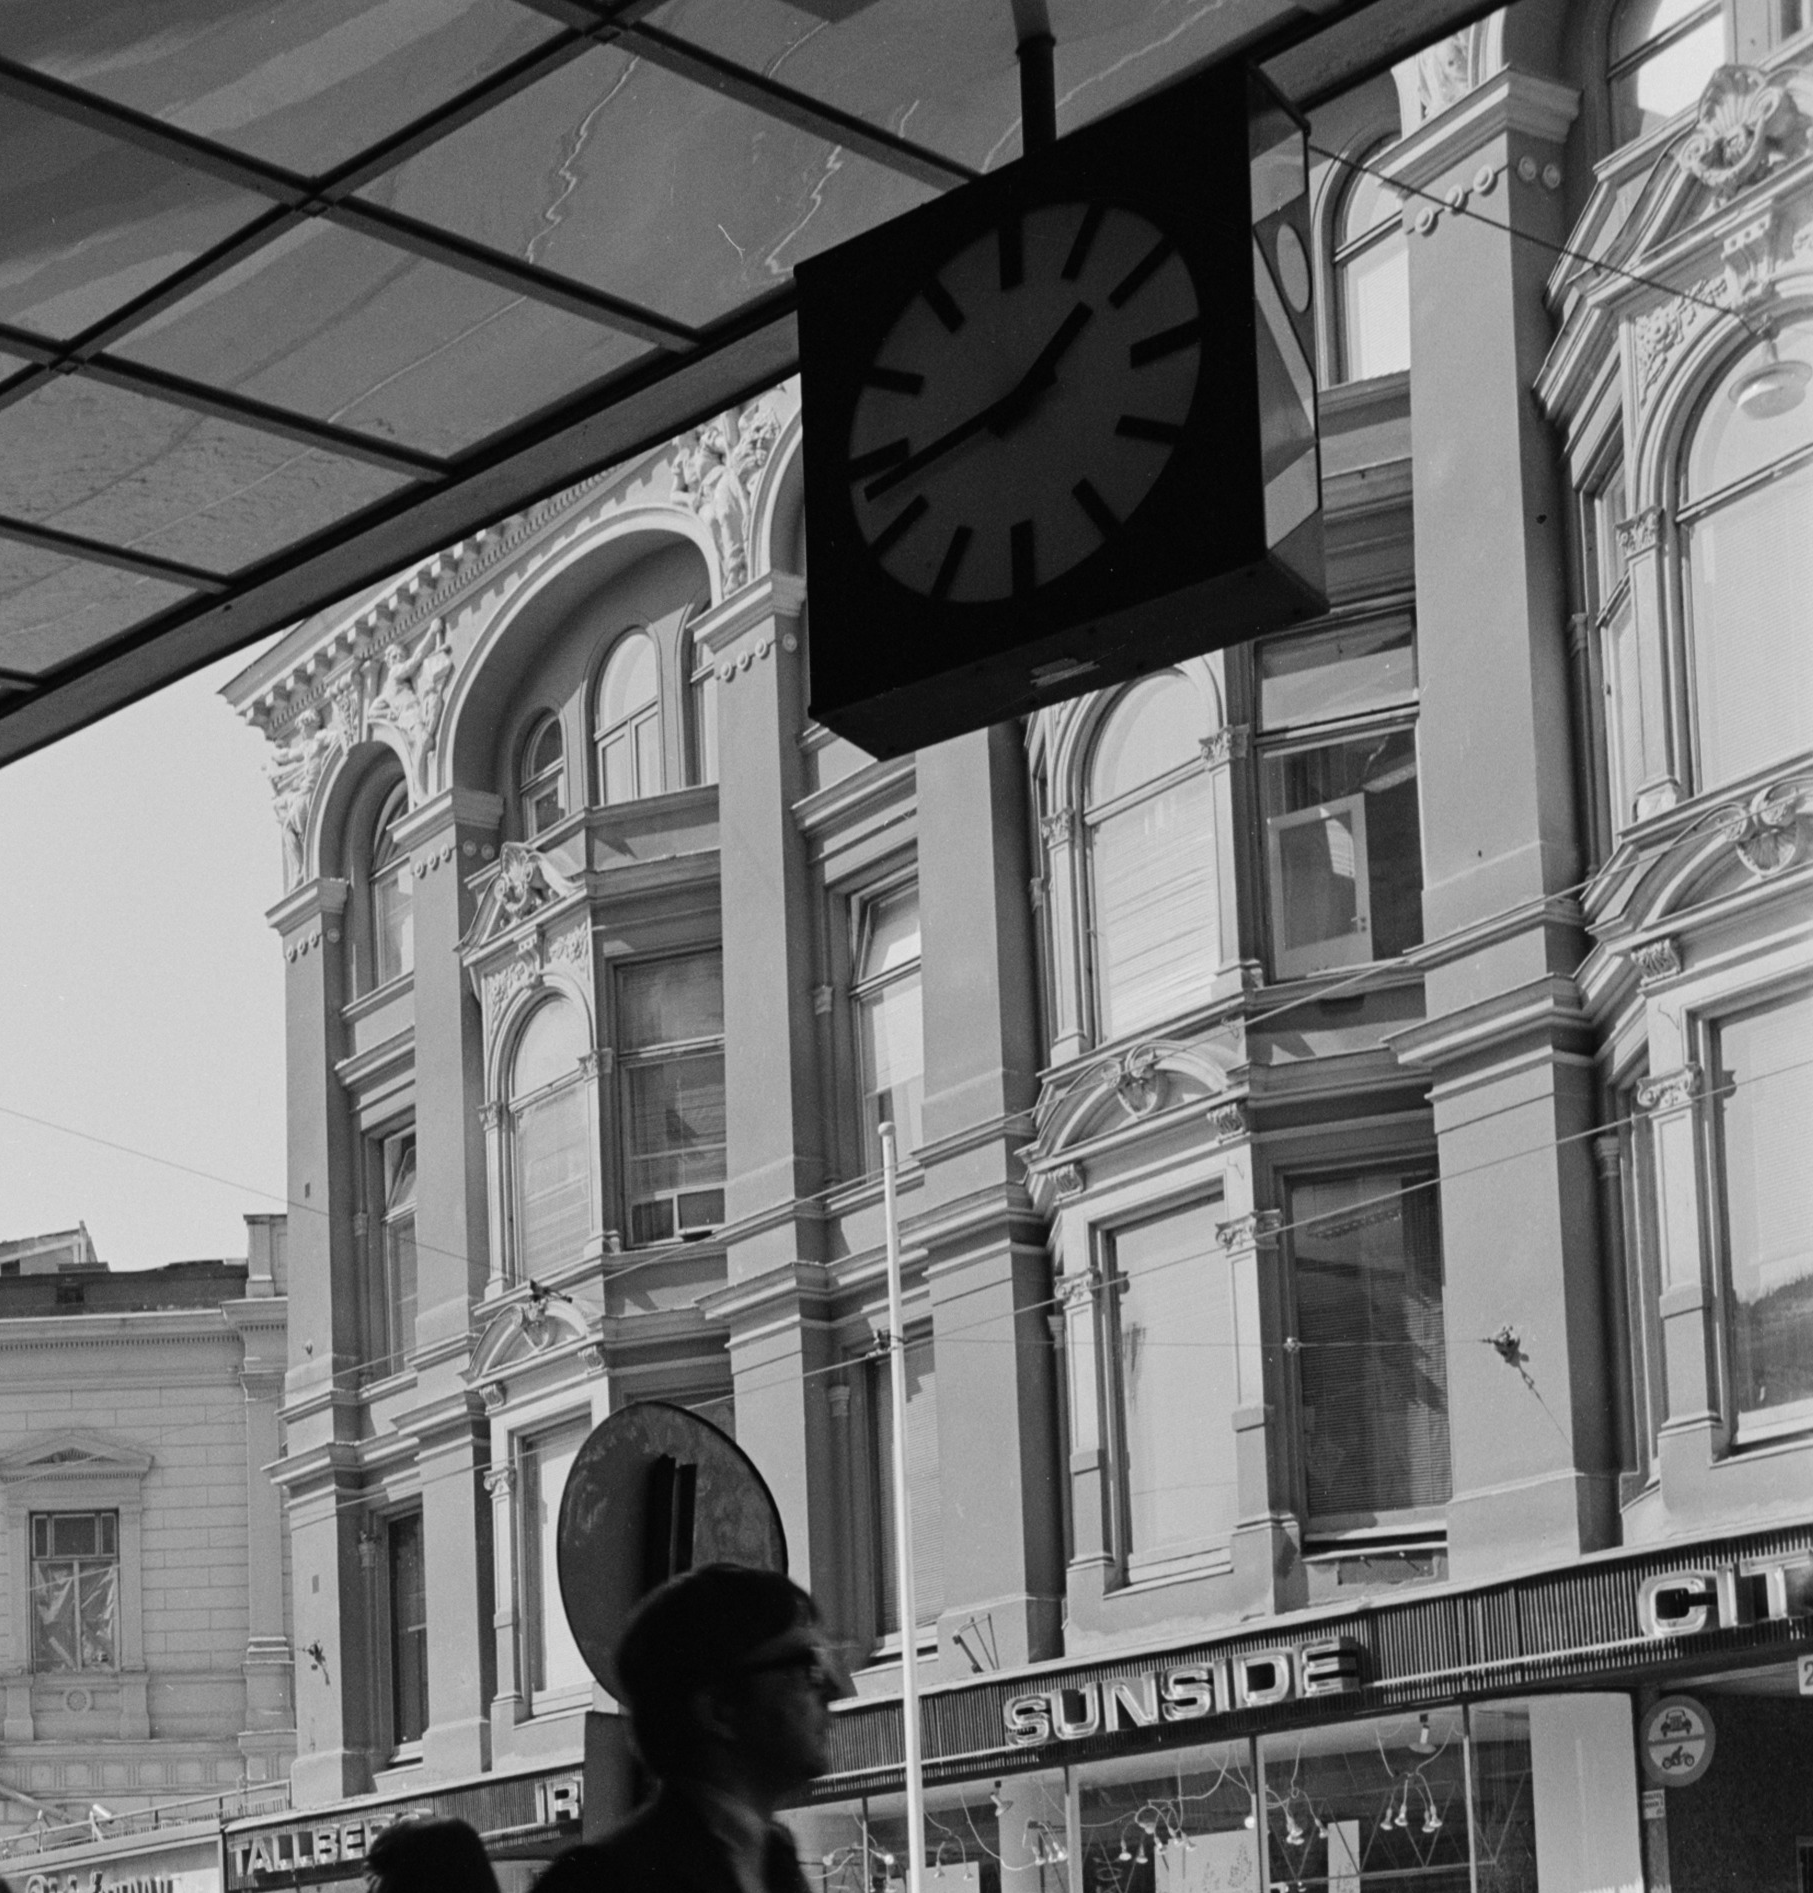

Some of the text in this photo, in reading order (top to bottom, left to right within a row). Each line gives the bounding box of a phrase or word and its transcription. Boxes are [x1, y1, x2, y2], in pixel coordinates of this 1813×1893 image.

[1638, 1548, 1813, 1639] CIT
[1003, 1640, 1363, 1748] SUNSIDE
[225, 1808, 432, 1878] TALLBER
